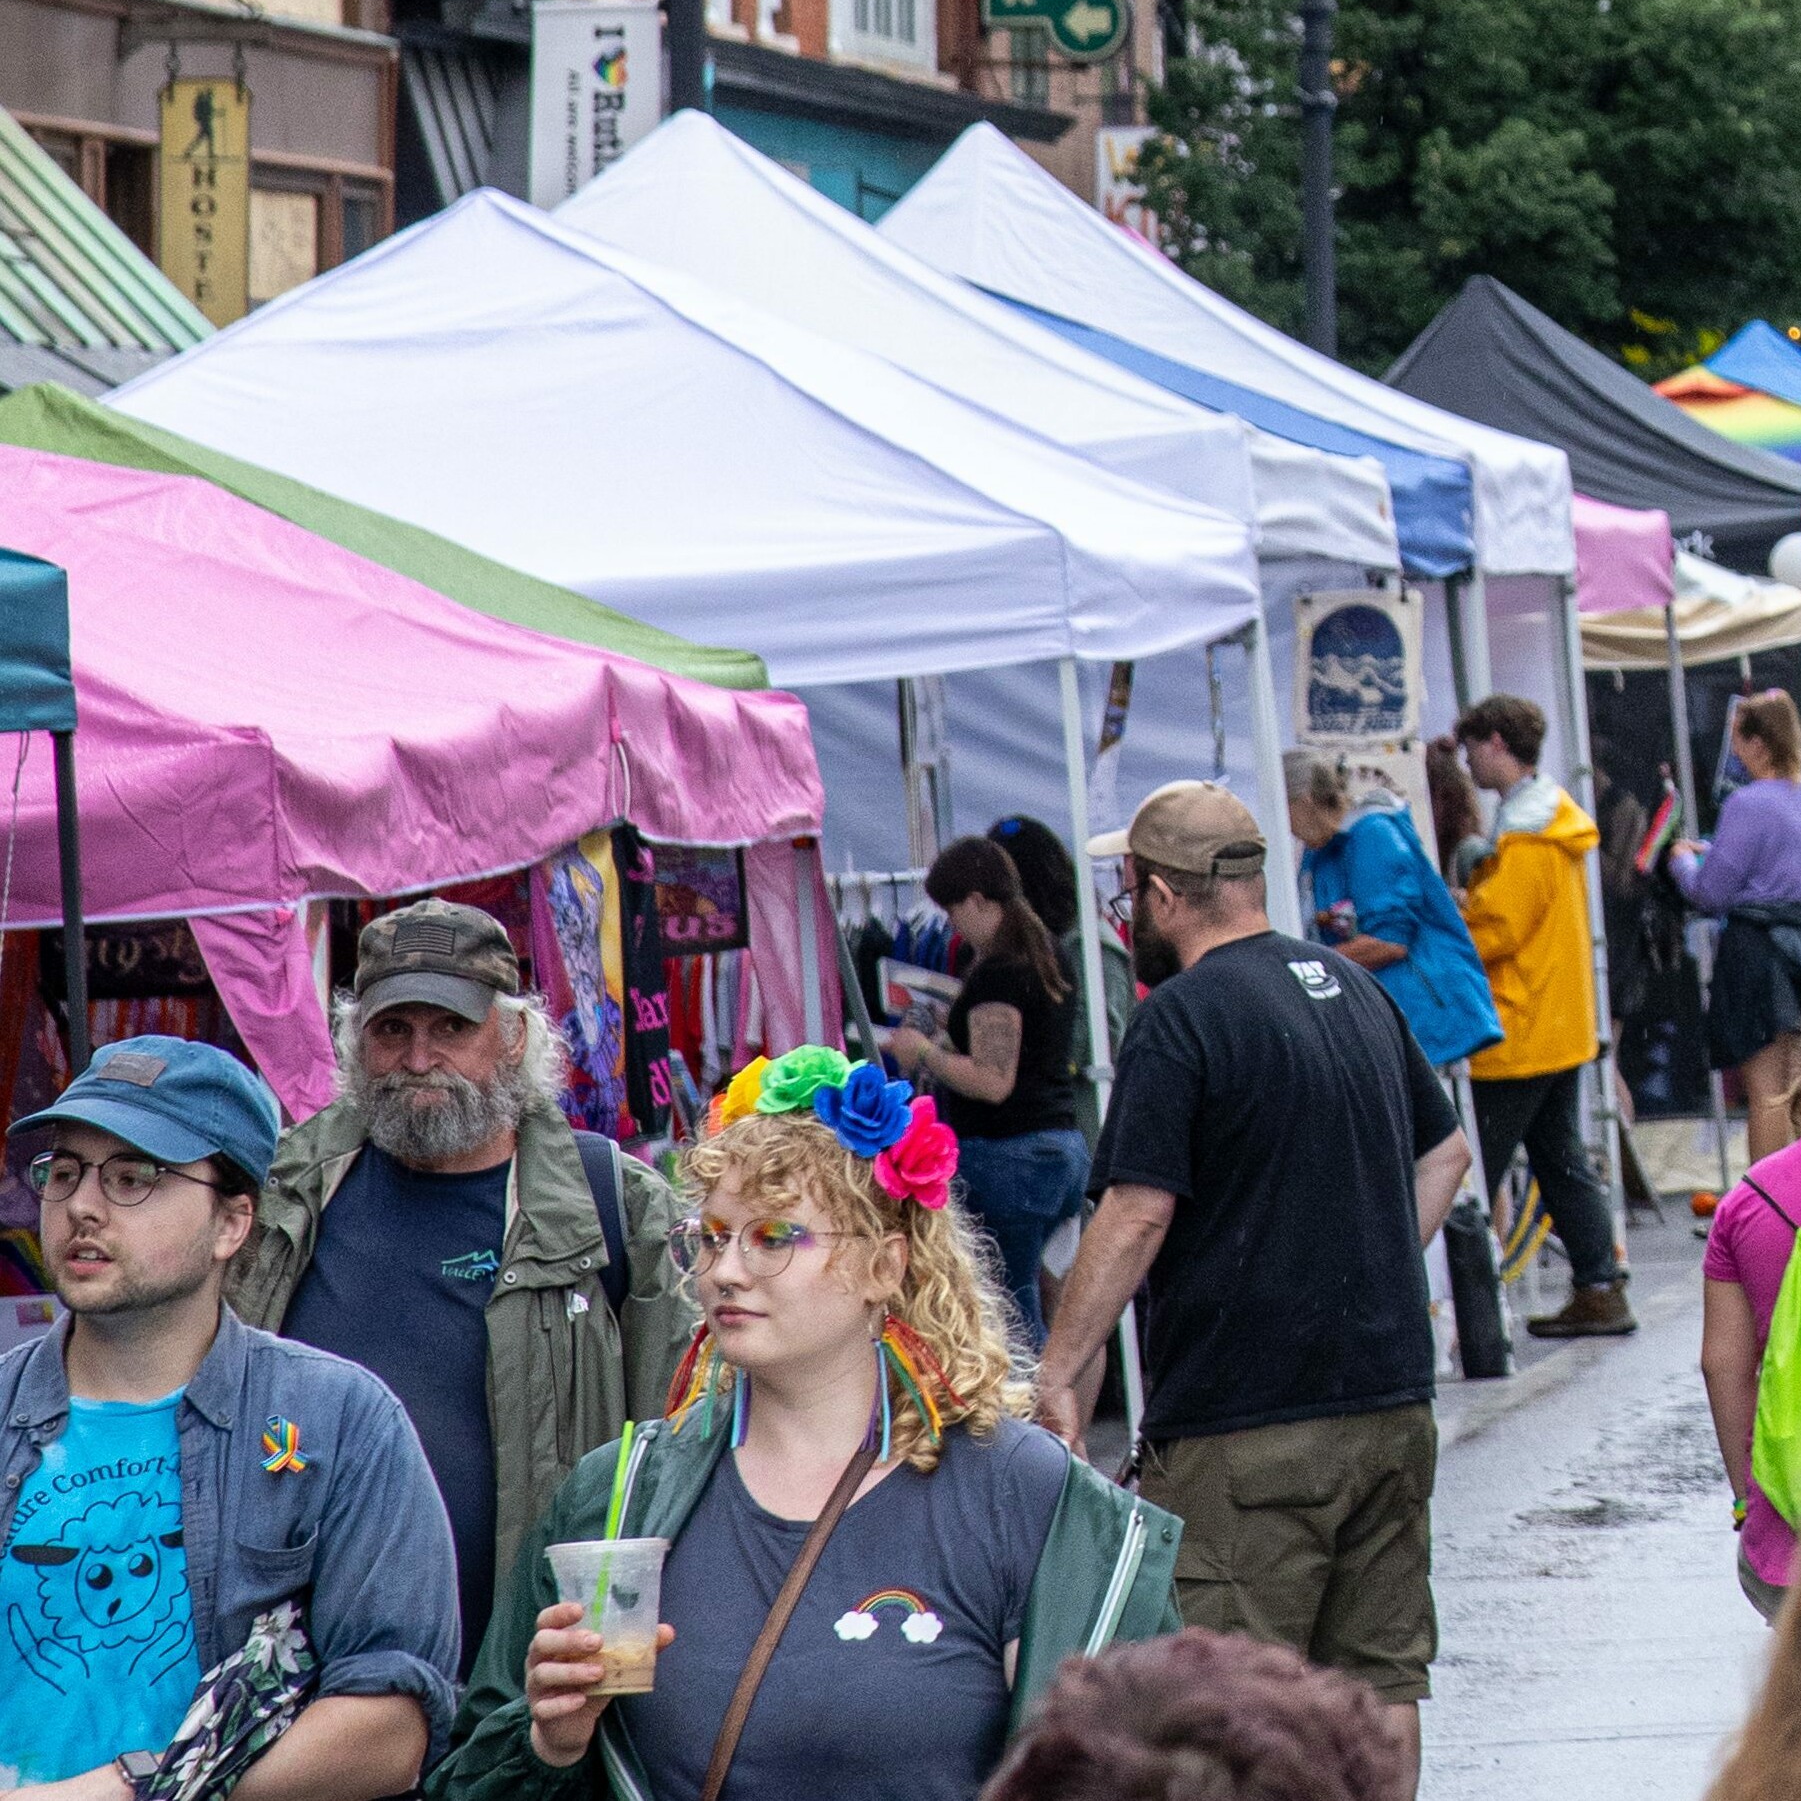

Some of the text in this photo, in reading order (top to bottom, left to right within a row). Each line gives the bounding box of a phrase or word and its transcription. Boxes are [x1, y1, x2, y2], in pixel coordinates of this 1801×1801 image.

[595, 25, 624, 38] I
[190, 166, 217, 302] HOSTE
[441, 1265, 485, 1282] VALLE
[52, 1455, 167, 1494] Comfort
